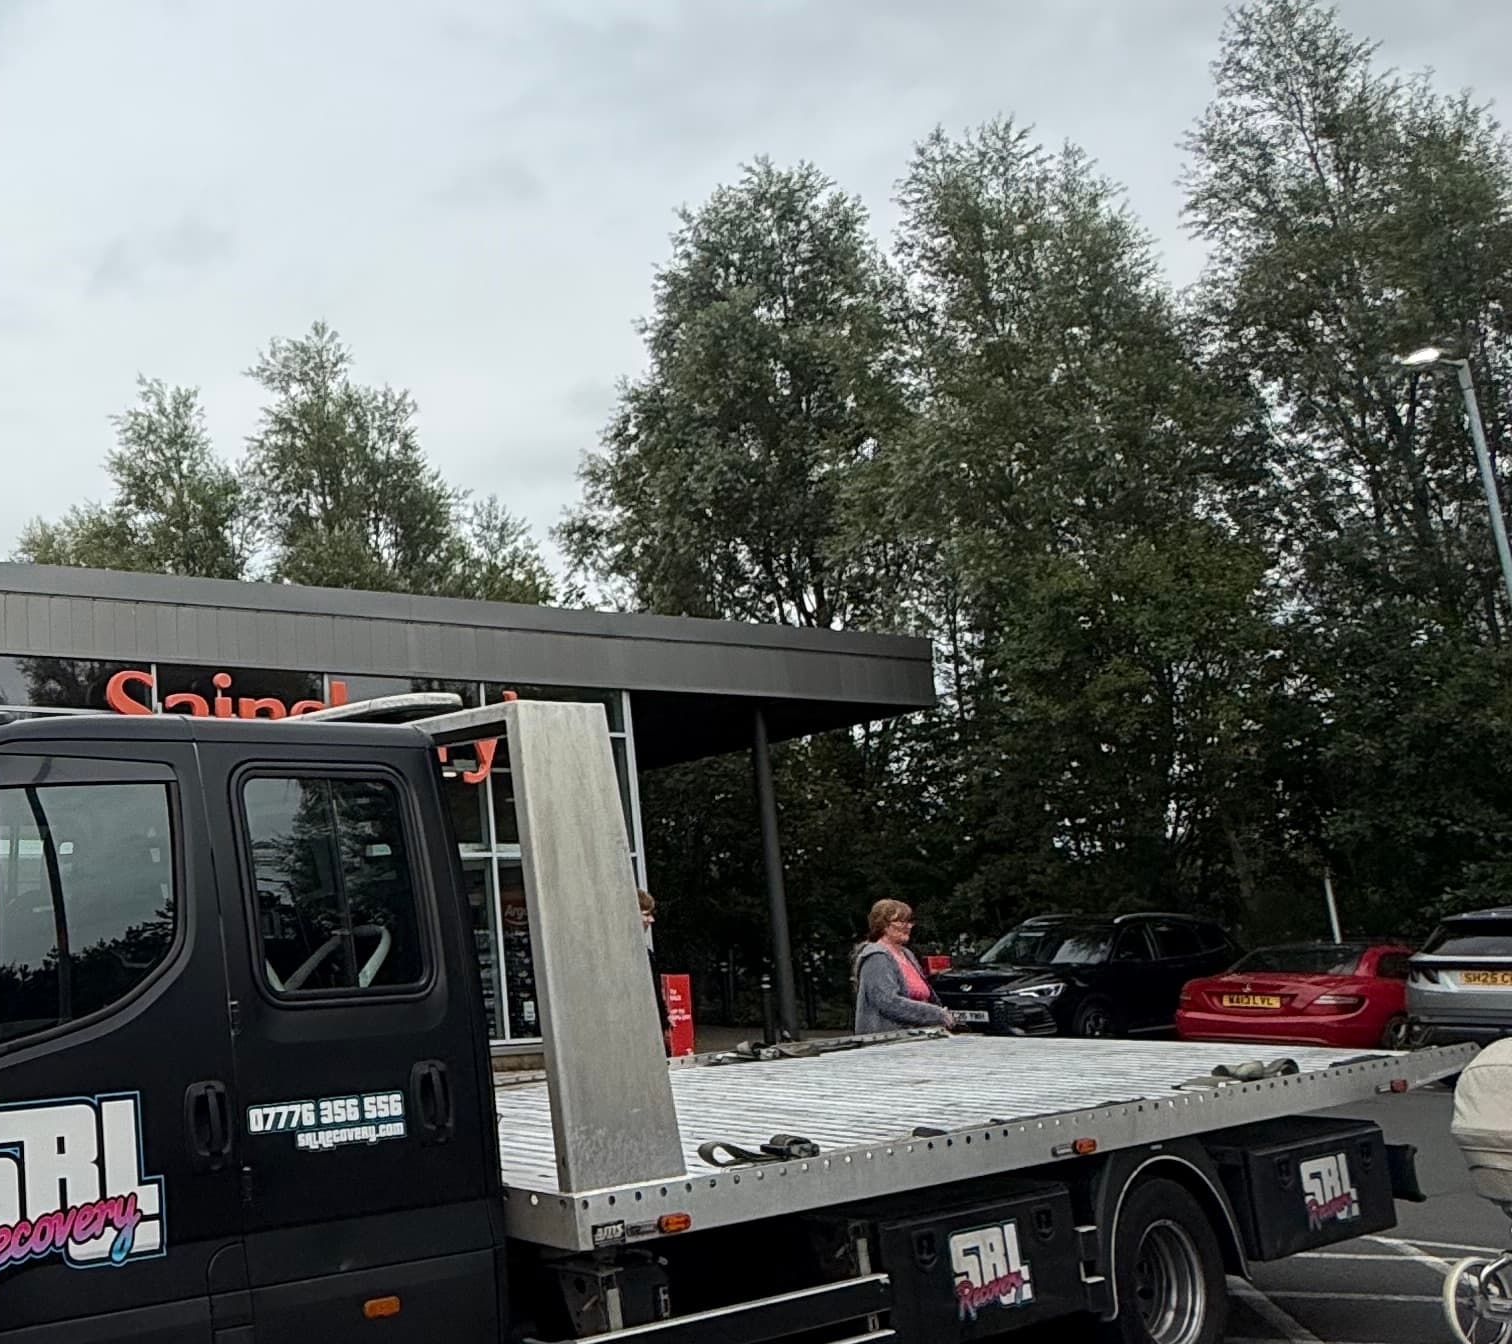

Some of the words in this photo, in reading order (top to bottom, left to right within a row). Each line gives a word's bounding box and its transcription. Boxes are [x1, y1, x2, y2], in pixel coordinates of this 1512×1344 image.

[1501, 972, 1512, 984] C
[249, 1102, 316, 1133] 07776
[319, 1098, 360, 1124] 356
[363, 1093, 403, 1119] 556
[955, 1270, 1024, 1321] Recovery
